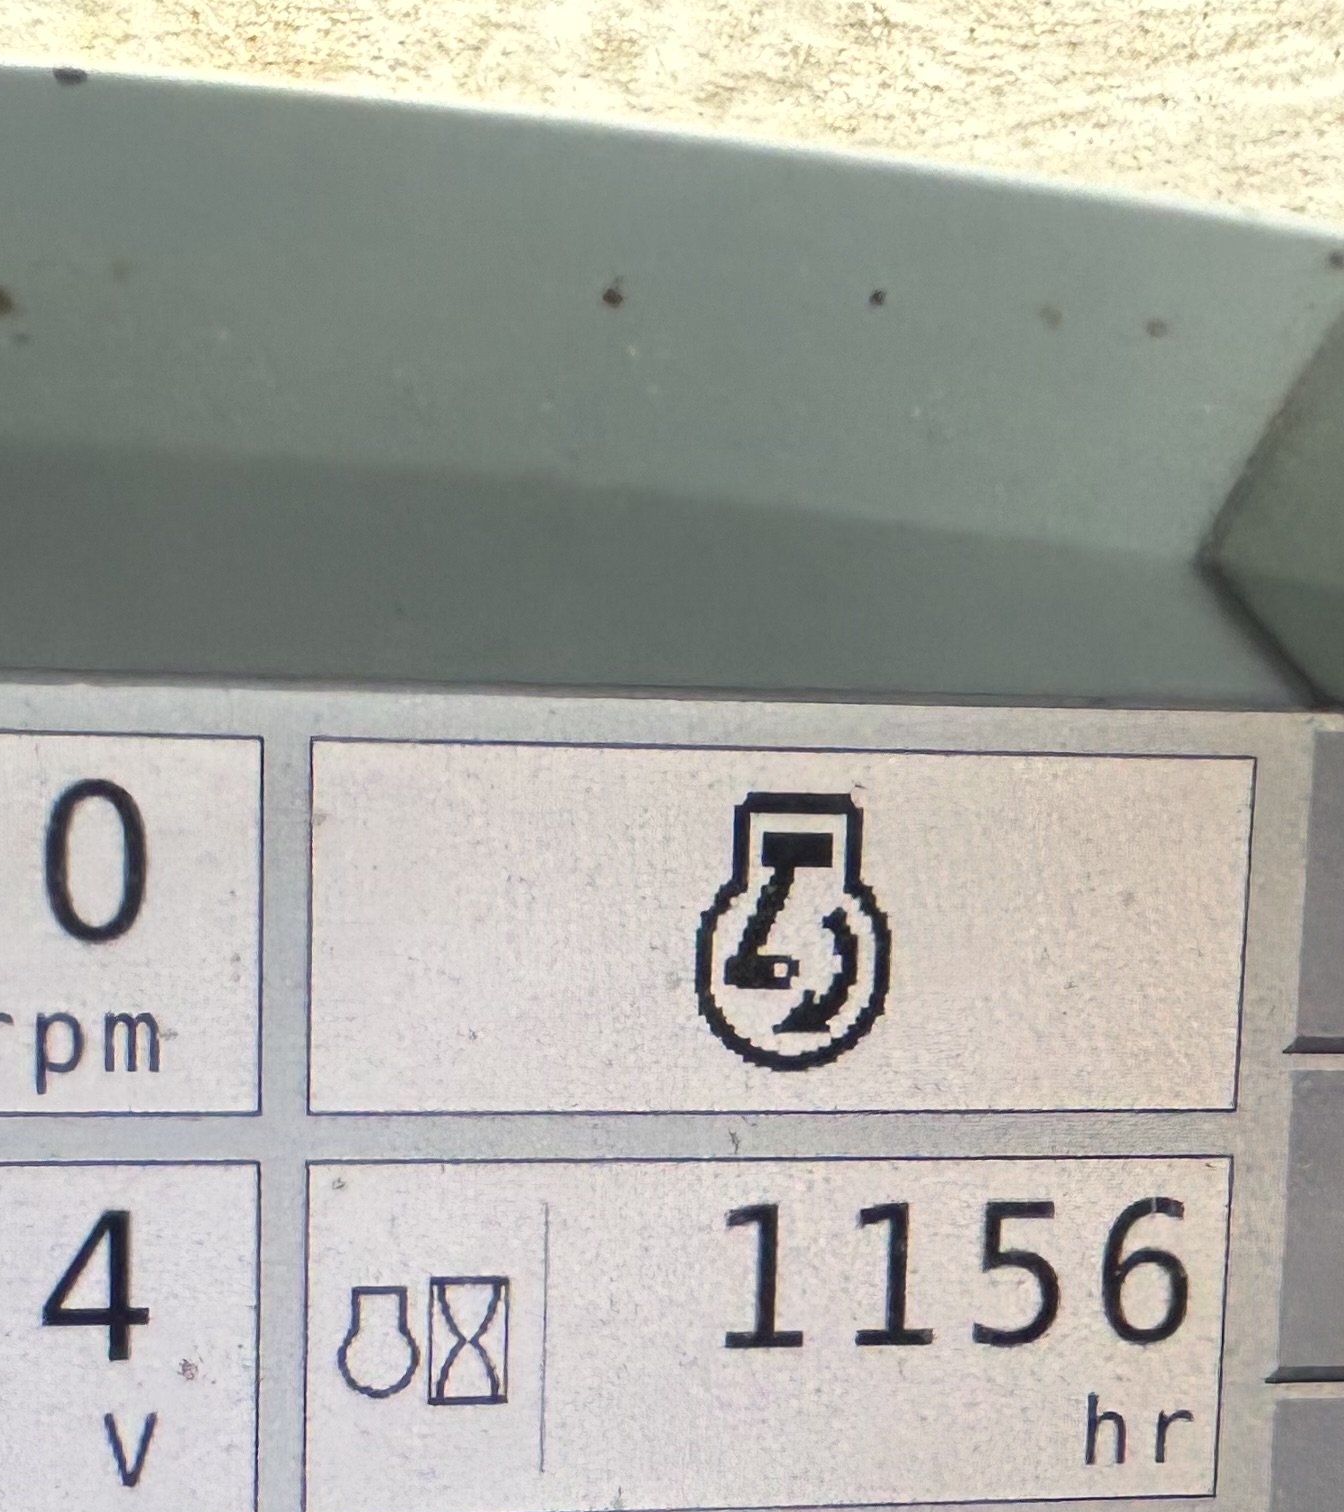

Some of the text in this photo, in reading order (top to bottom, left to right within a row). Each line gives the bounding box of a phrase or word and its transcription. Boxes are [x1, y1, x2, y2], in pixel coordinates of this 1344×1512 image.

[45, 777, 147, 944] 0
[724, 1195, 1189, 1351] 1156
[104, 1412, 157, 1489] V
[1085, 1392, 1193, 1466] hr
